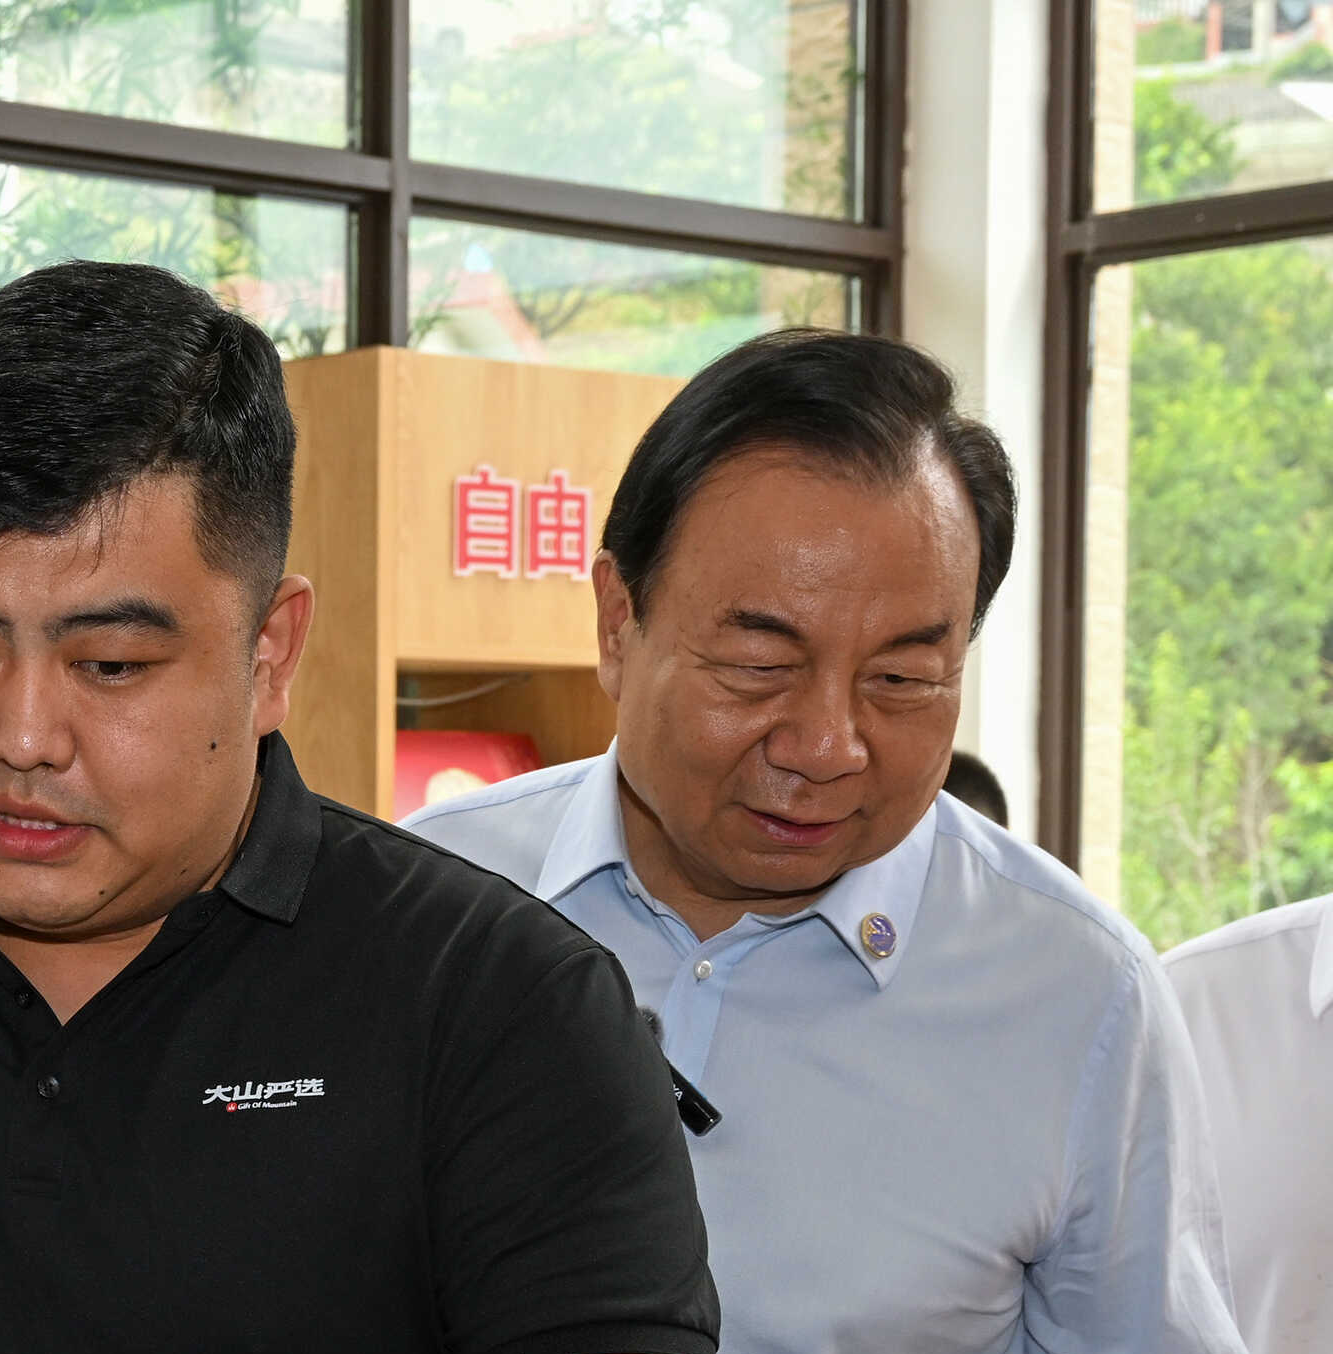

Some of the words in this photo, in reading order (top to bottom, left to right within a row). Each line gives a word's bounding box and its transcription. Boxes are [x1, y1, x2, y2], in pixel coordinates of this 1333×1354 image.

[454, 464, 592, 581] 自由
[202, 1078, 325, 1105] 大山严选
[237, 1103, 251, 1111] Gift
[251, 1101, 262, 1109] Of
[262, 1100, 297, 1109] Mountain
